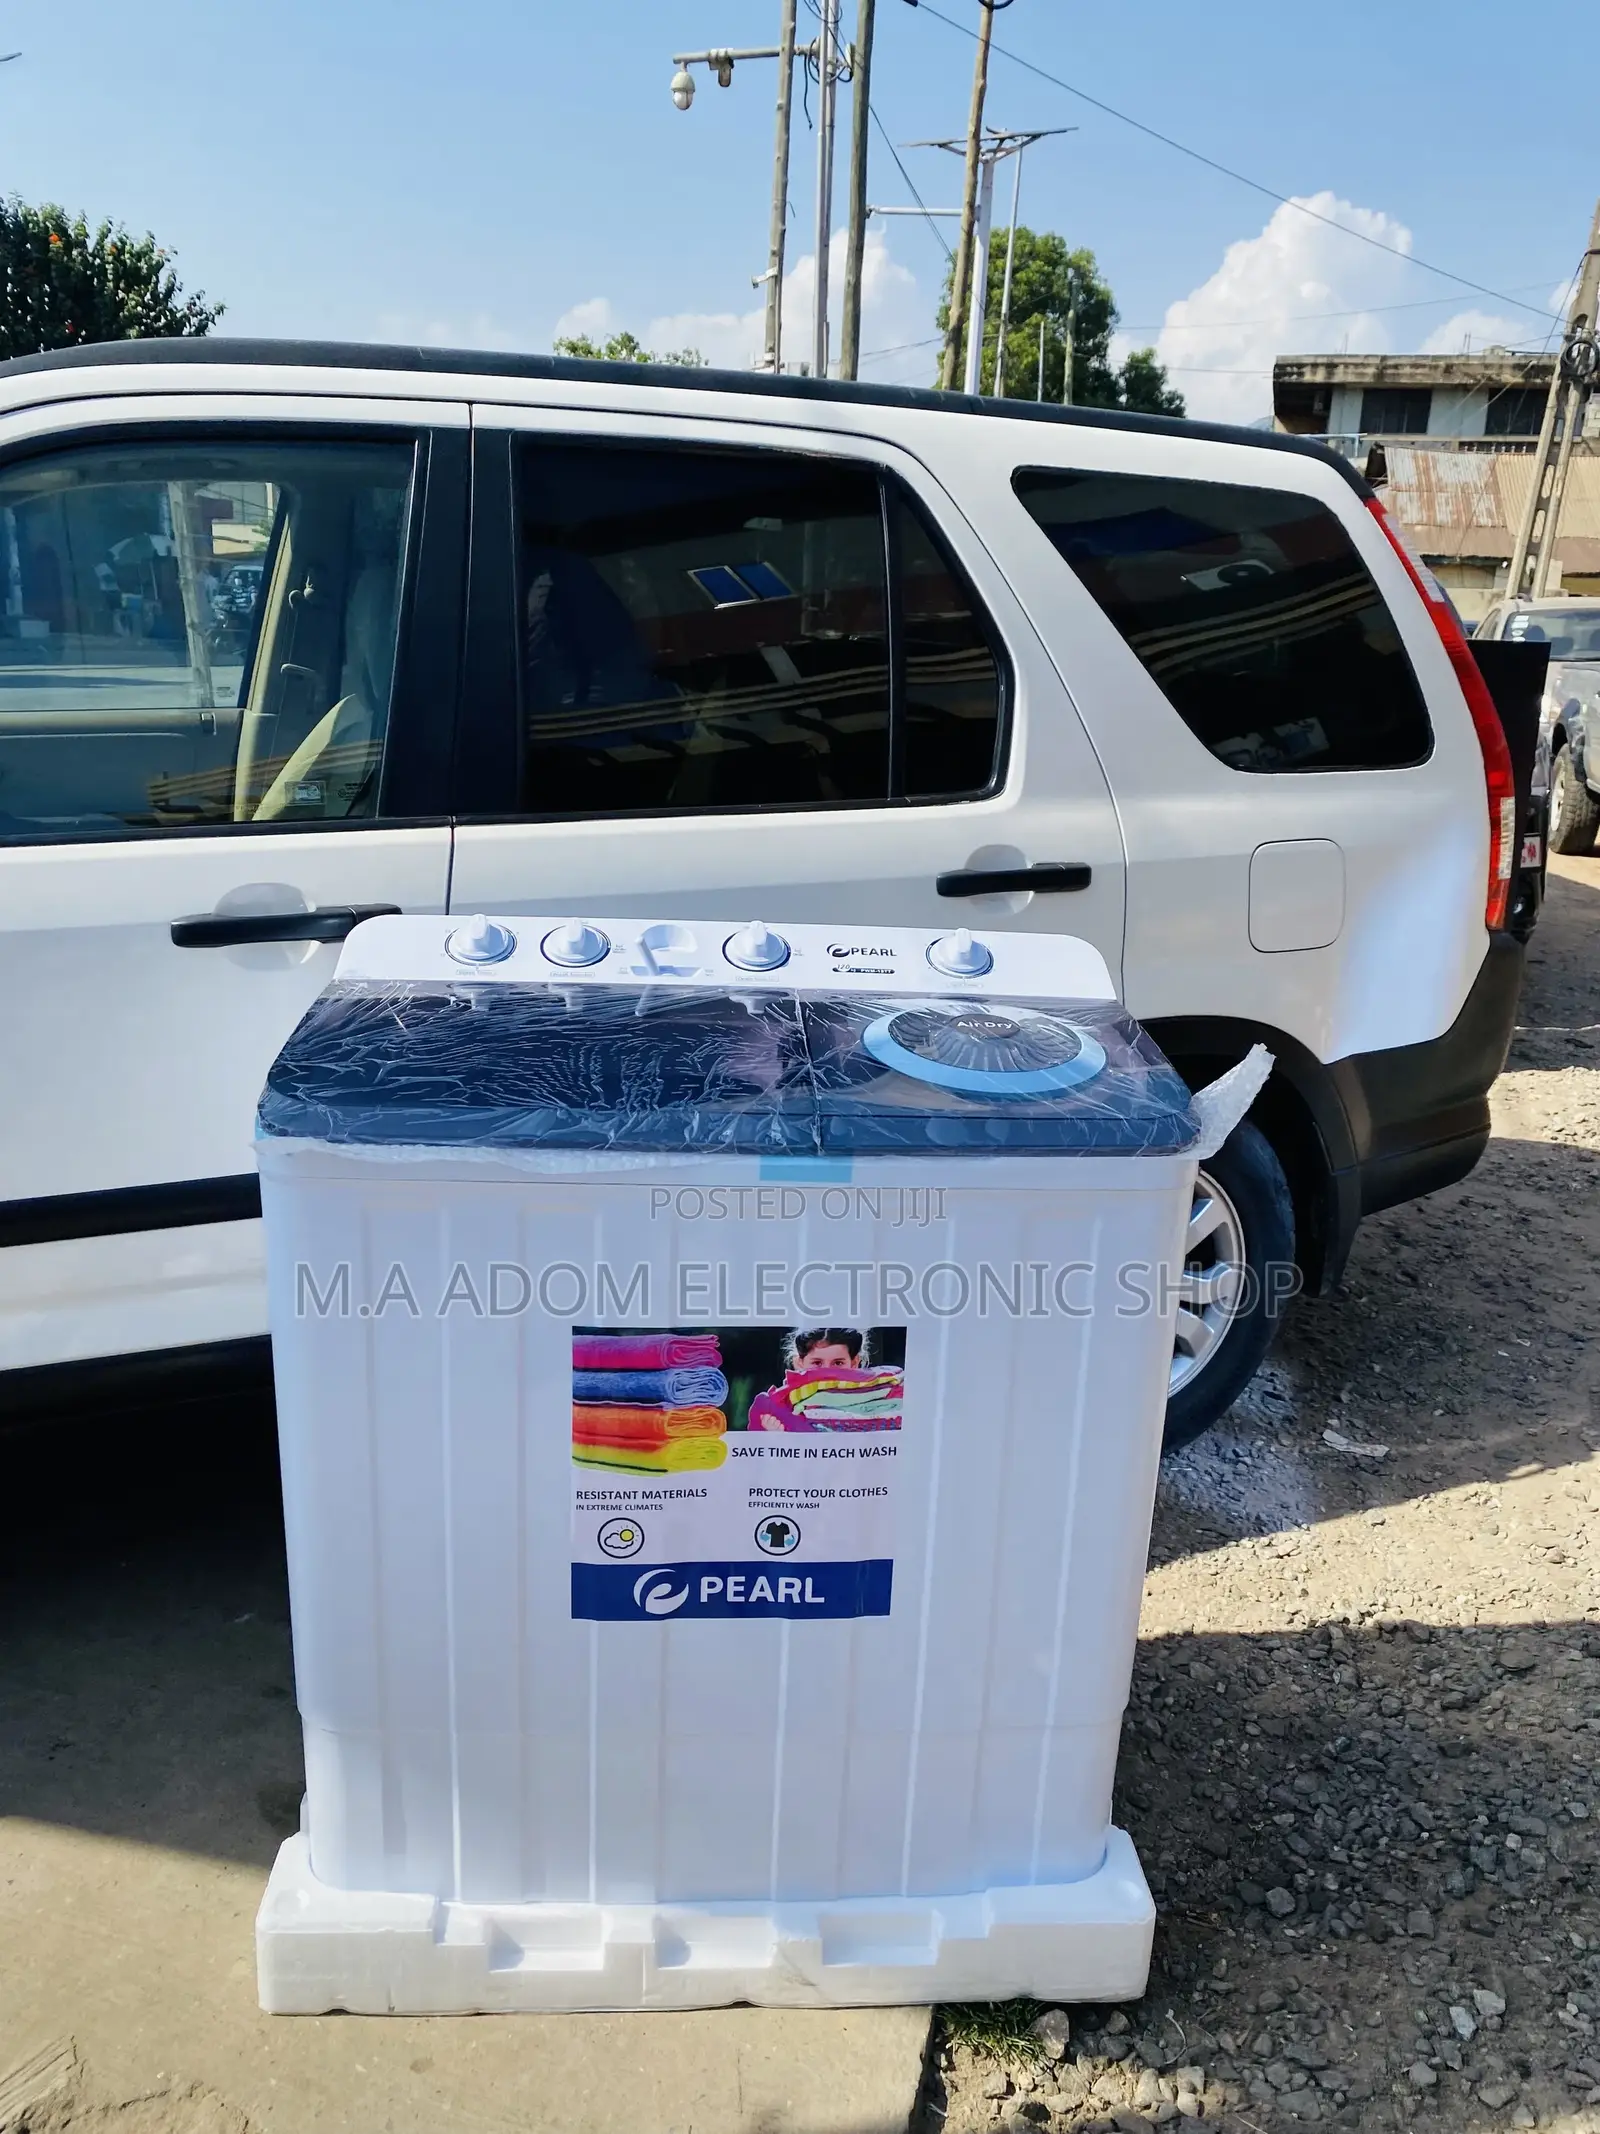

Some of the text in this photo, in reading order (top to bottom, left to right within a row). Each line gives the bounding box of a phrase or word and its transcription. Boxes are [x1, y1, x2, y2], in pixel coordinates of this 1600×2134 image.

[850, 946, 898, 957] PEARL
[957, 1020, 1012, 1029] Air Dry
[731, 1446, 898, 1459] SAVE TIME IN EACH WASH
[576, 1488, 708, 1500] RESISTANT MATERIALS
[749, 1486, 889, 1498] PROTECT YOUR CLOTHES
[624, 1503, 664, 1511] CLIMATES
[747, 1501, 795, 1509] EFFICIENTLY
[700, 1575, 826, 1604] PEARL
